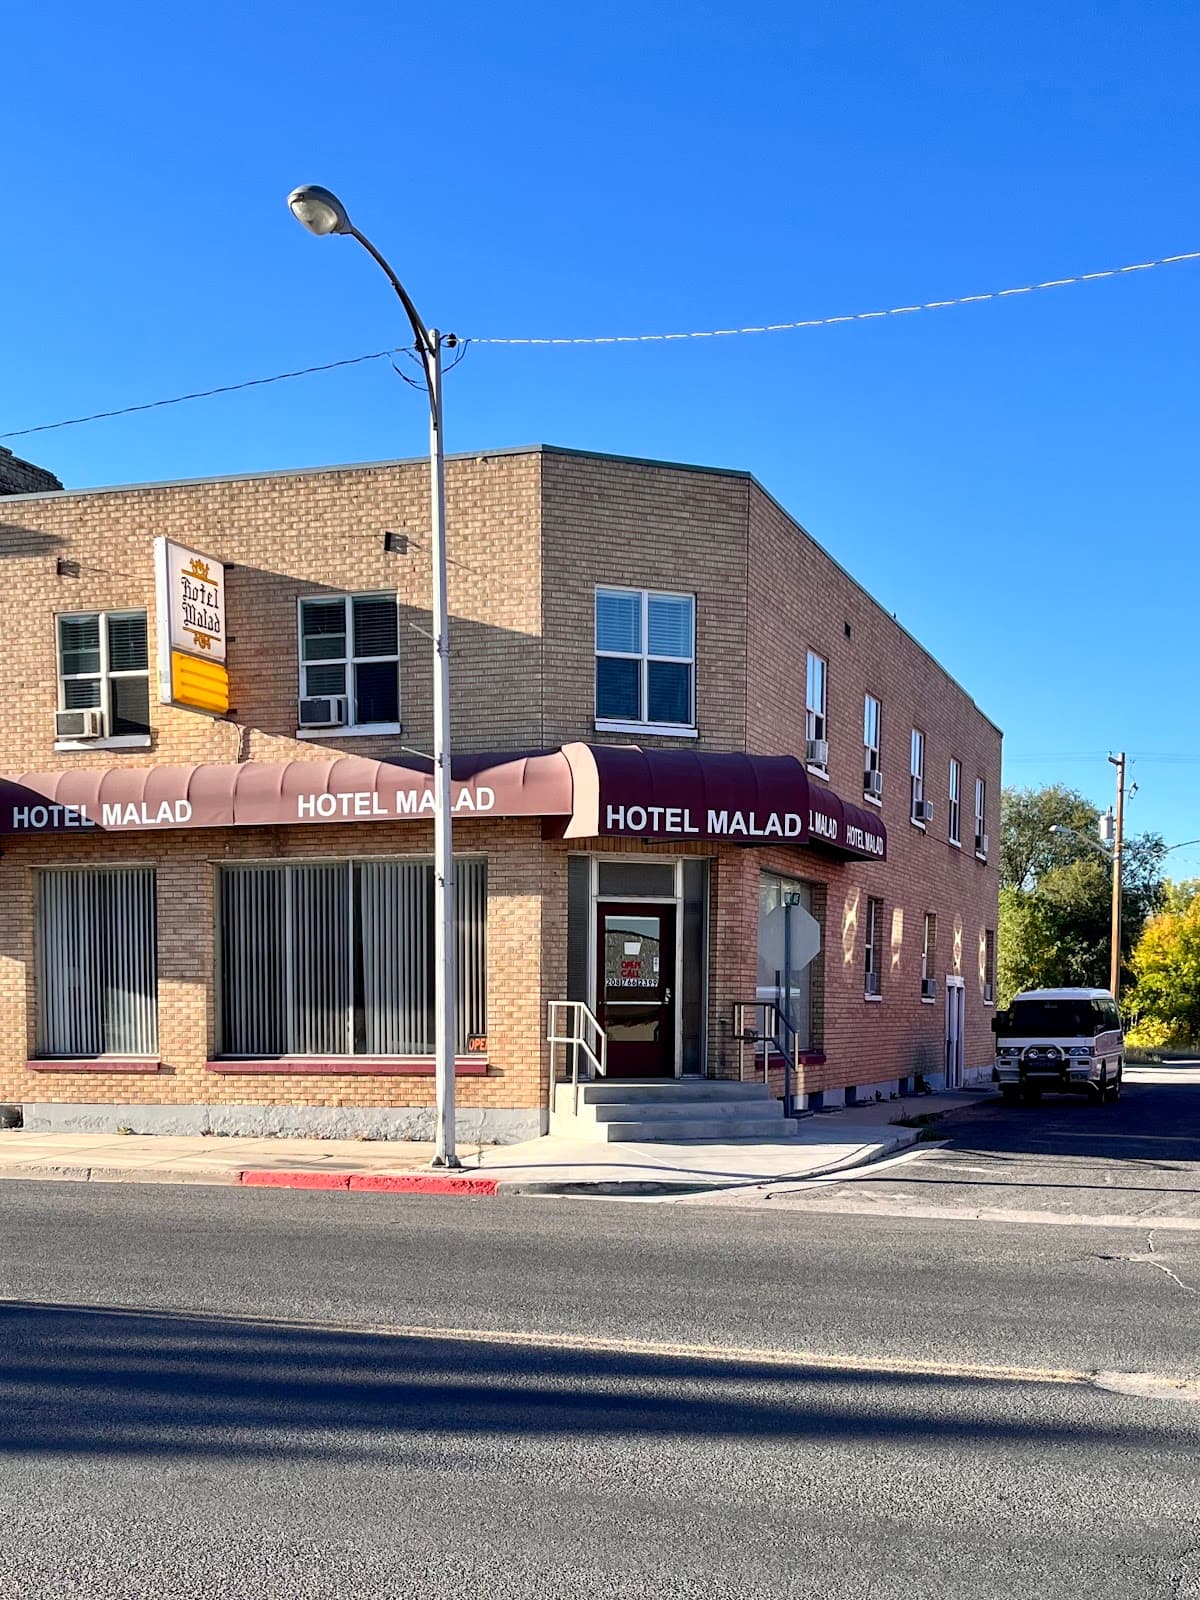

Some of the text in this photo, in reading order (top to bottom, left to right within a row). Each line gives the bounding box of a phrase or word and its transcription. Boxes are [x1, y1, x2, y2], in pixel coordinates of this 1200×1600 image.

[182, 601, 220, 633] Malad
[12, 799, 192, 829] HOTEL MALAD
[297, 787, 495, 818] HOTEL MAAD
[606, 804, 699, 833] HOTEL
[707, 809, 802, 837] MALAD
[815, 811, 838, 840] MALAD
[846, 824, 884, 856] HOTEL MALAD
[620, 969, 641, 978] CALL
[621, 961, 641, 969] OPEN
[468, 1037, 487, 1051] OPE
